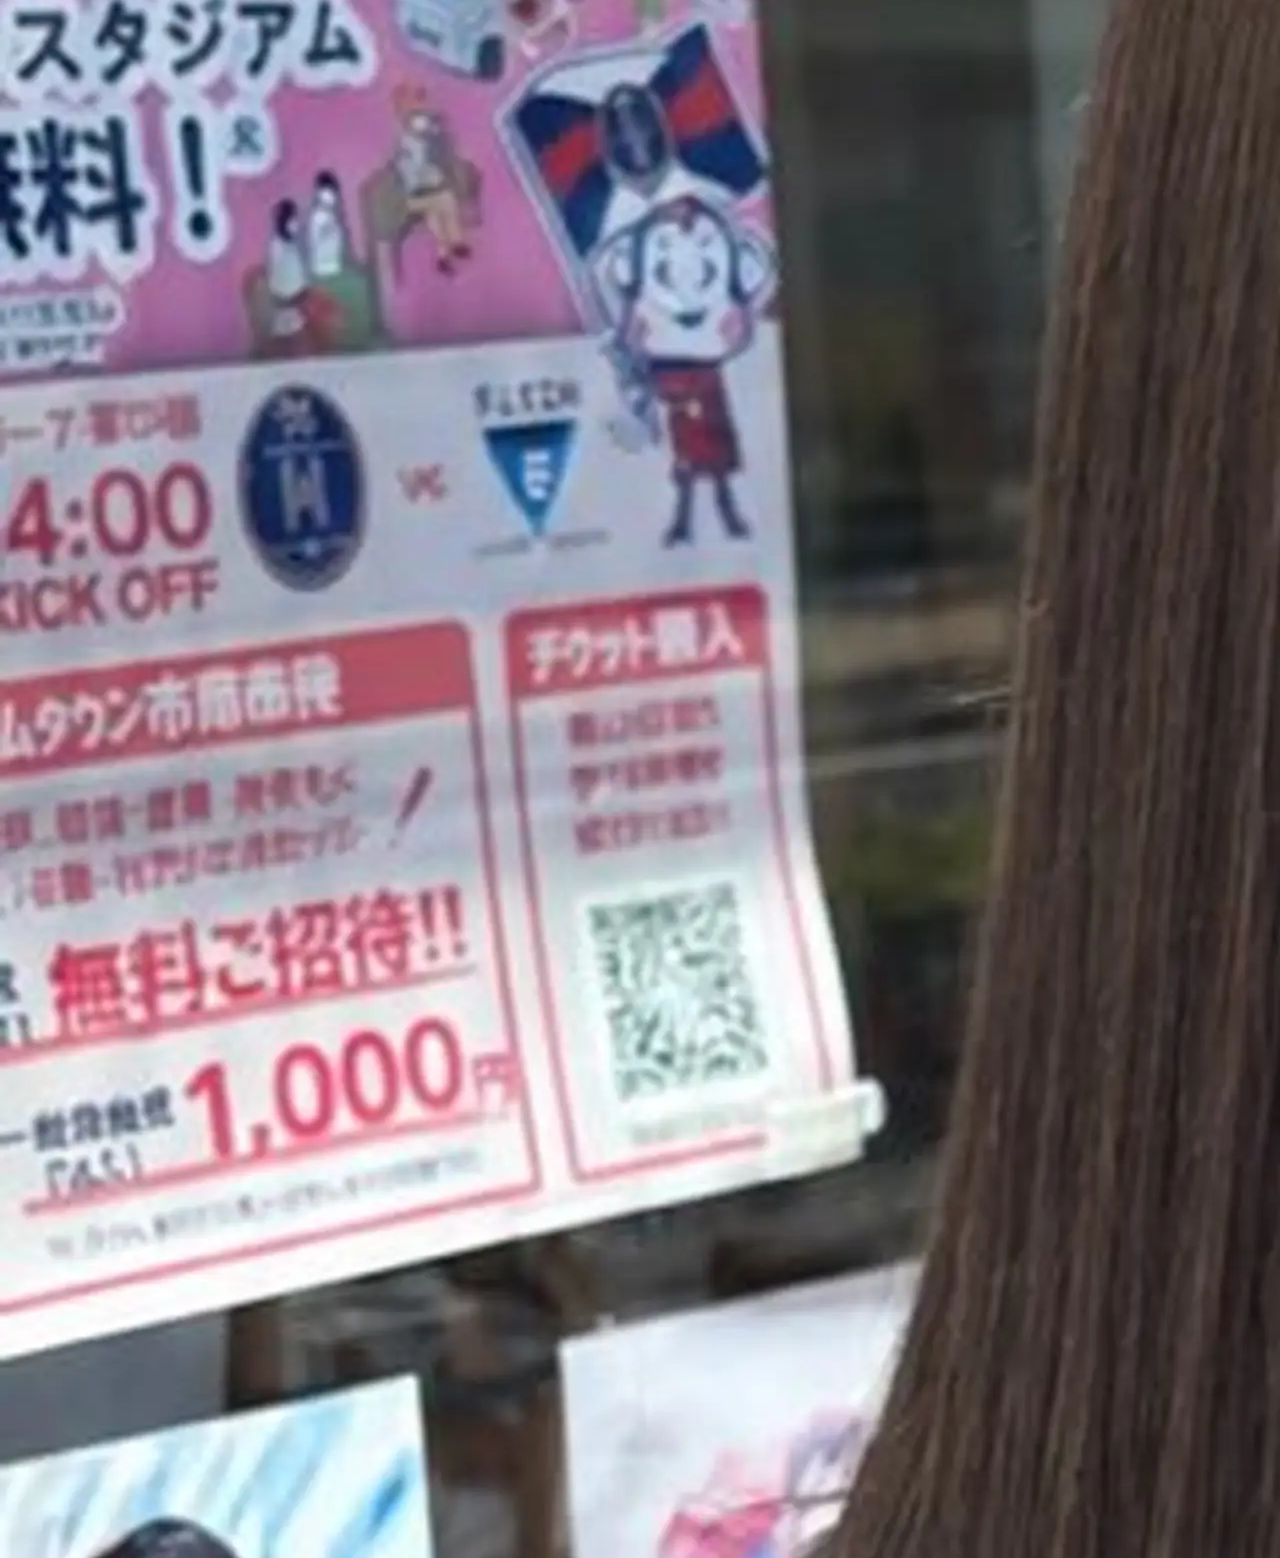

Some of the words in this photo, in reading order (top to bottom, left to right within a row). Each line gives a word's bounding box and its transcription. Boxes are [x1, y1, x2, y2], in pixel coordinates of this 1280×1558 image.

[0, 114, 213, 259] 料!
[7, 461, 213, 567] 4:00
[117, 554, 221, 622] OFF
